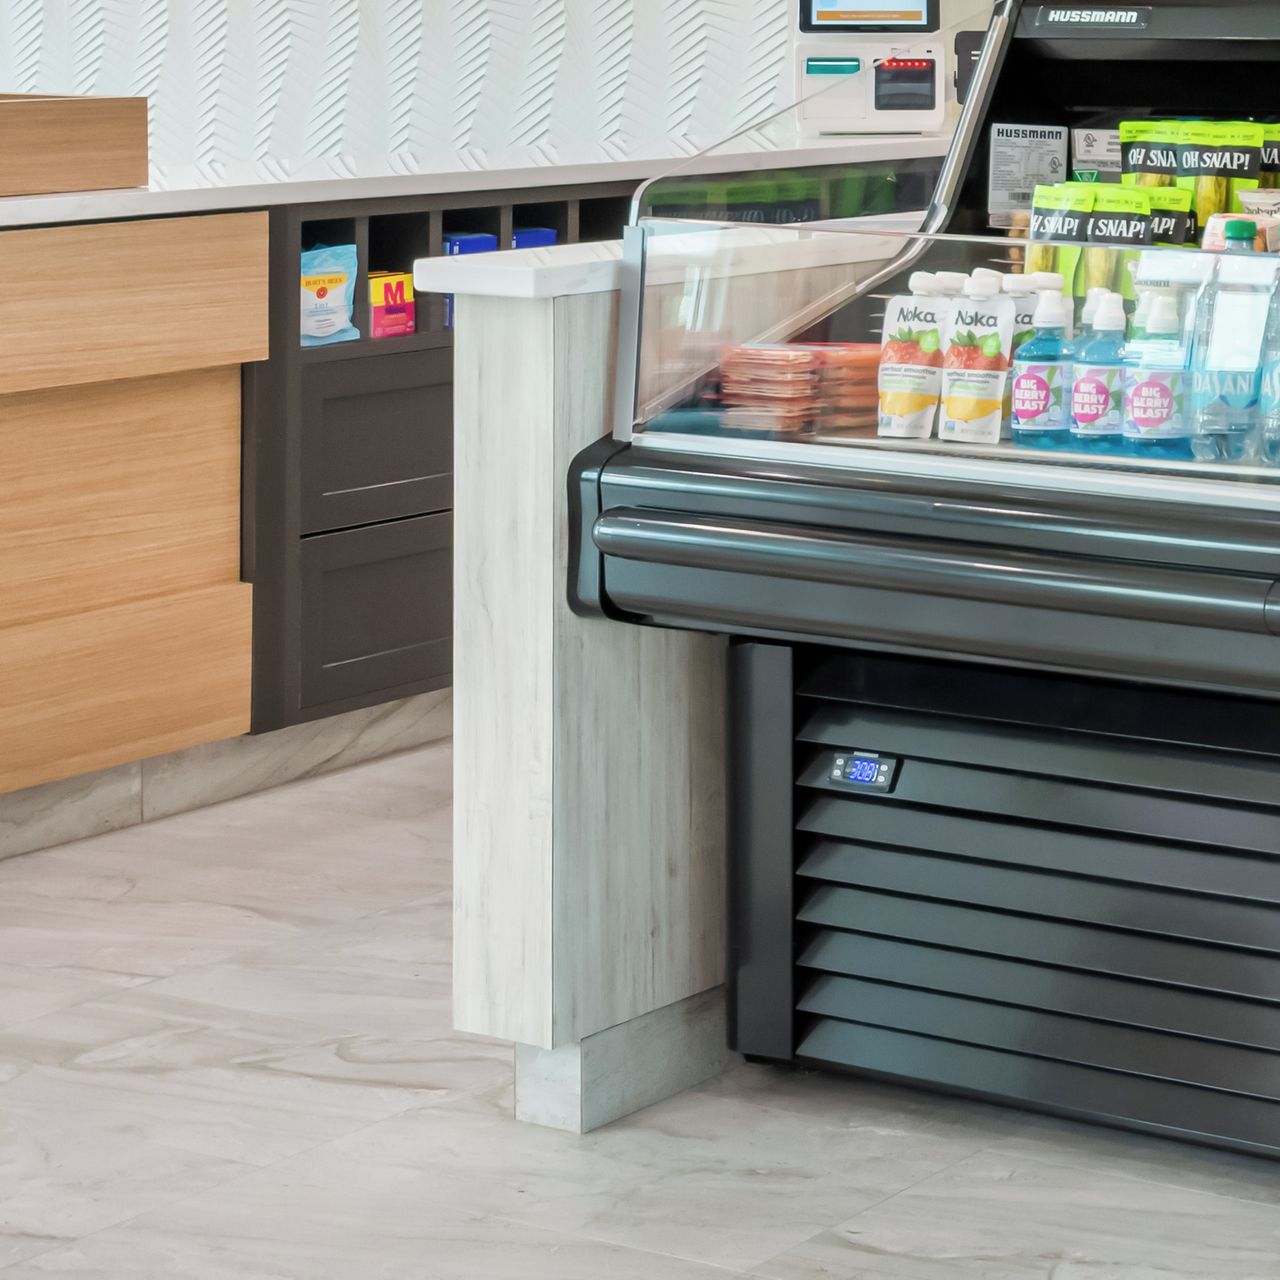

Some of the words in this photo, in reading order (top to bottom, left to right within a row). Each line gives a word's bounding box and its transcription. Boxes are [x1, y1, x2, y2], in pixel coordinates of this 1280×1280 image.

[1048, 10, 1138, 23] HUSSMANN
[997, 128, 1062, 140] HUSSMANN
[1128, 149, 1146, 165] OH
[1183, 151, 1199, 168] OH
[1200, 152, 1250, 170] SNAP!
[1042, 216, 1079, 236] SNAP!
[1095, 219, 1146, 238] SNAP!
[897, 306, 937, 323] Noka
[955, 310, 998, 327] Noka
[1020, 379, 1037, 390] BIG
[1079, 383, 1096, 393] BIG
[1015, 389, 1047, 400] BERRY
[1074, 393, 1106, 403] BERRY
[1141, 387, 1160, 398] BIG
[1015, 399, 1046, 411] BLAST
[1074, 403, 1105, 414] BLAST
[1133, 397, 1170, 408] BERRY
[1133, 408, 1169, 419] BLAST
